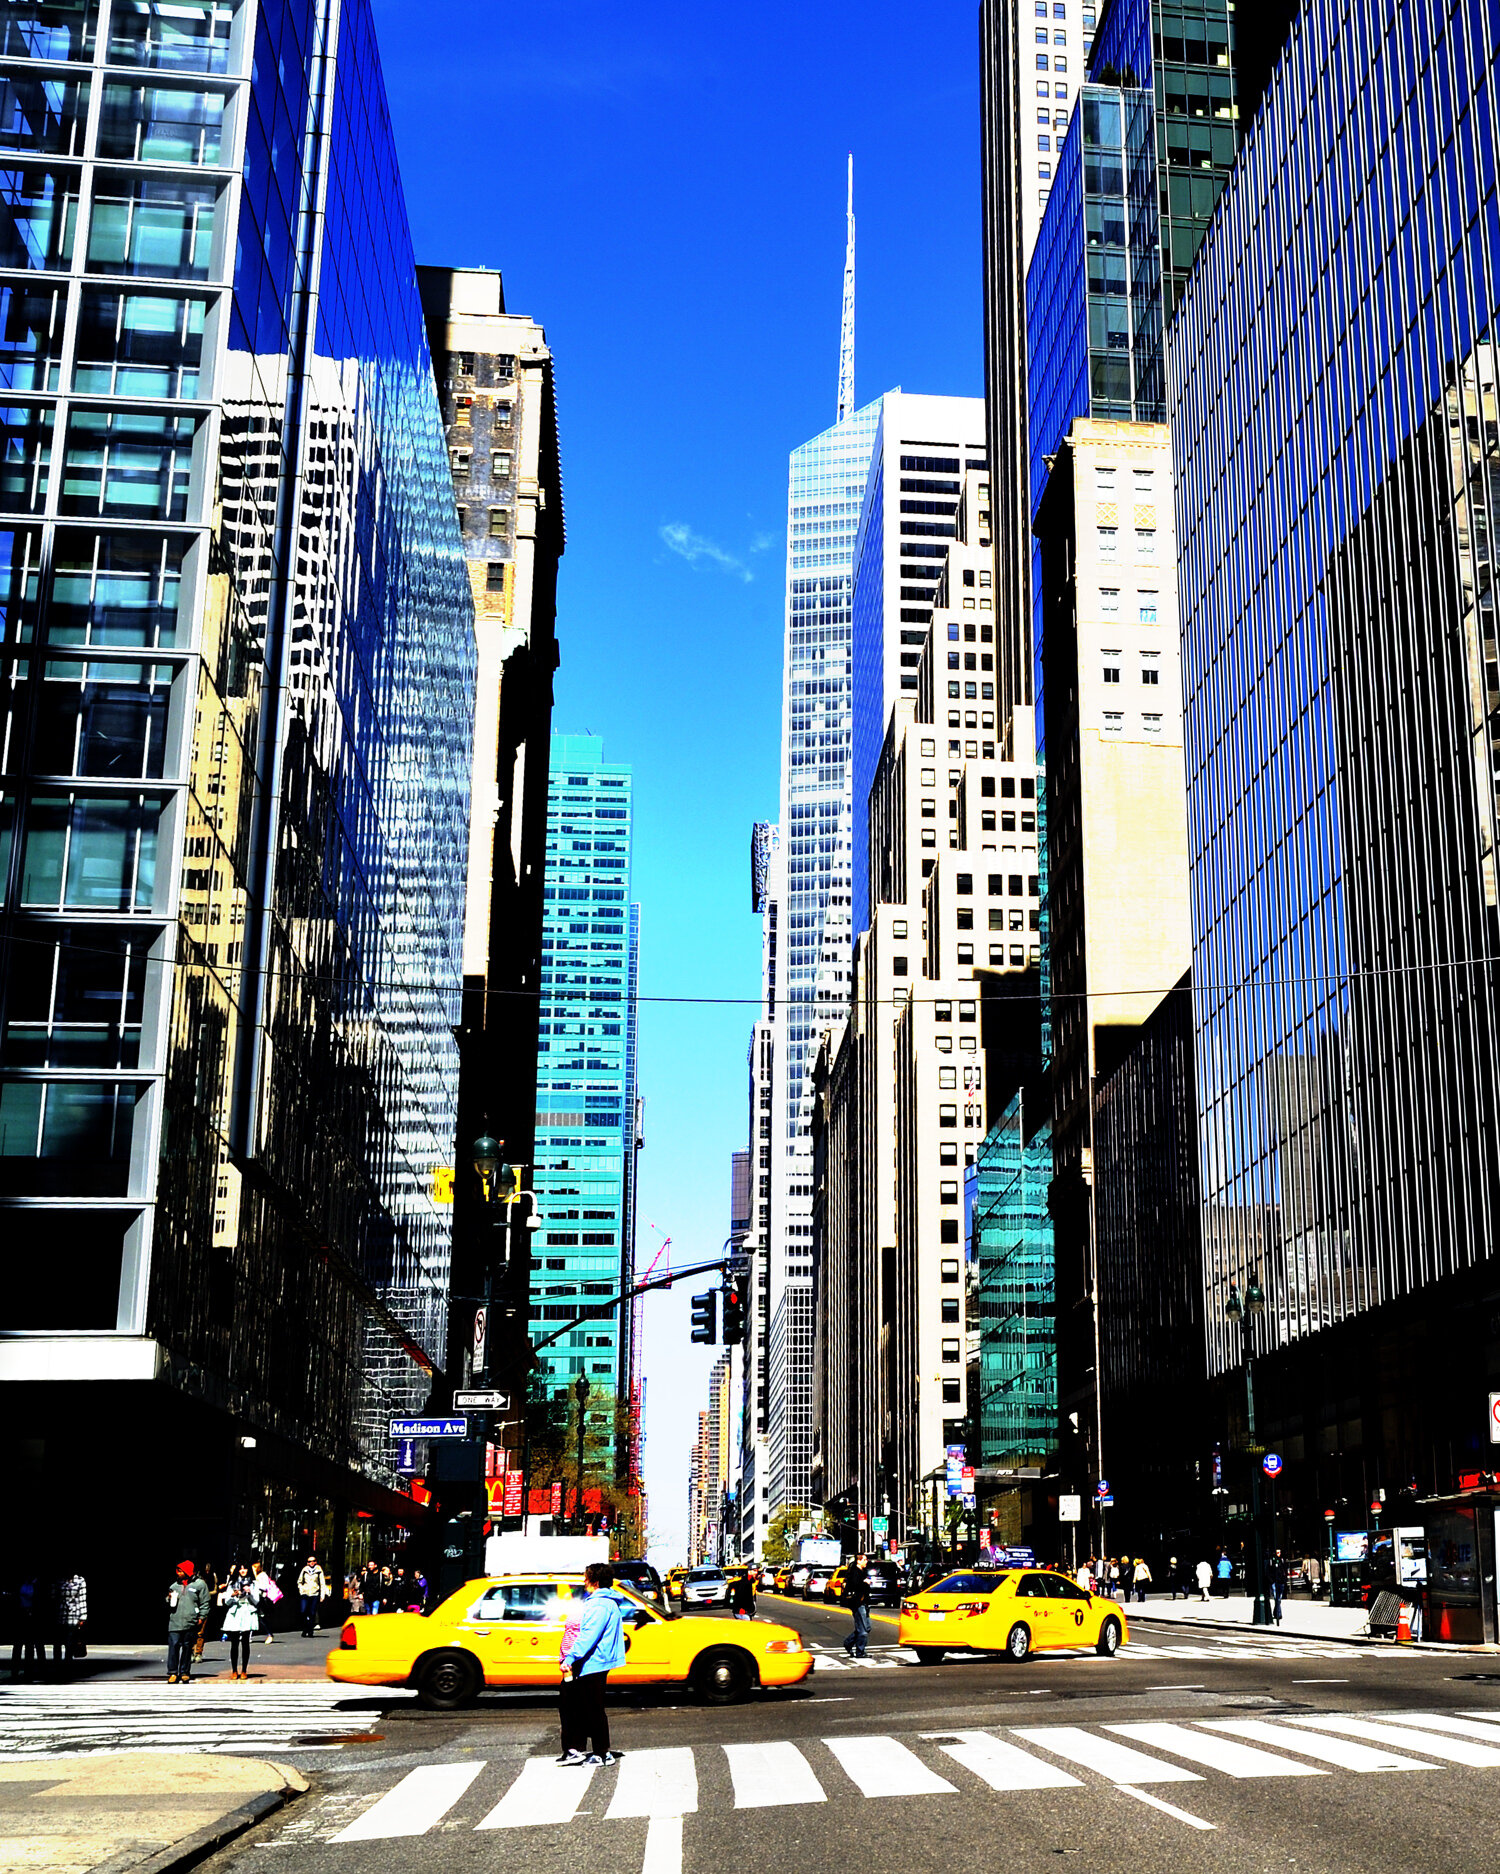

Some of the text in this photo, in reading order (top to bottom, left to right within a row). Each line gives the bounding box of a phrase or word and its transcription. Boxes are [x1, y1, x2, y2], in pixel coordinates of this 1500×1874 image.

[462, 1396, 501, 1404] ONE WAY
[392, 1422, 466, 1434] Madison Ave
